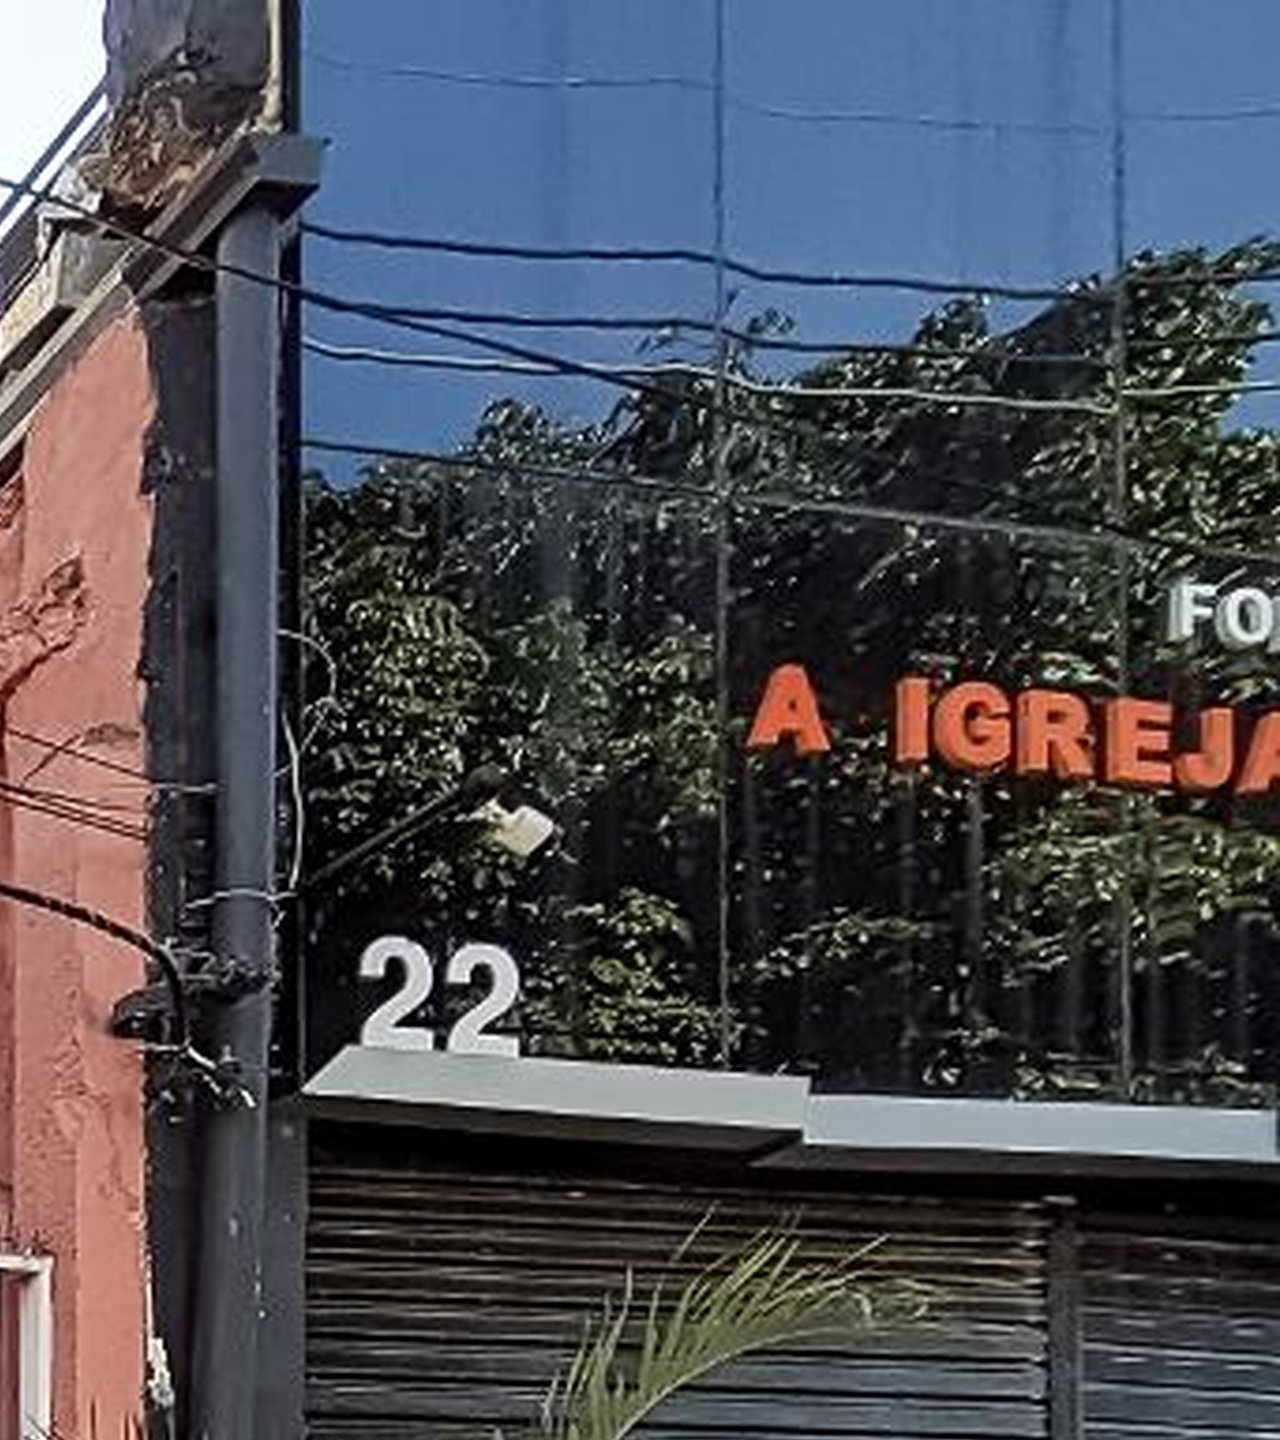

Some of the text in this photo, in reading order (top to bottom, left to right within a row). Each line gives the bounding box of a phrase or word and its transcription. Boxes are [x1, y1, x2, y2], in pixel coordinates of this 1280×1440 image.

[1168, 575, 1280, 653] FO
[746, 662, 829, 756] A
[358, 936, 521, 1057] 22
